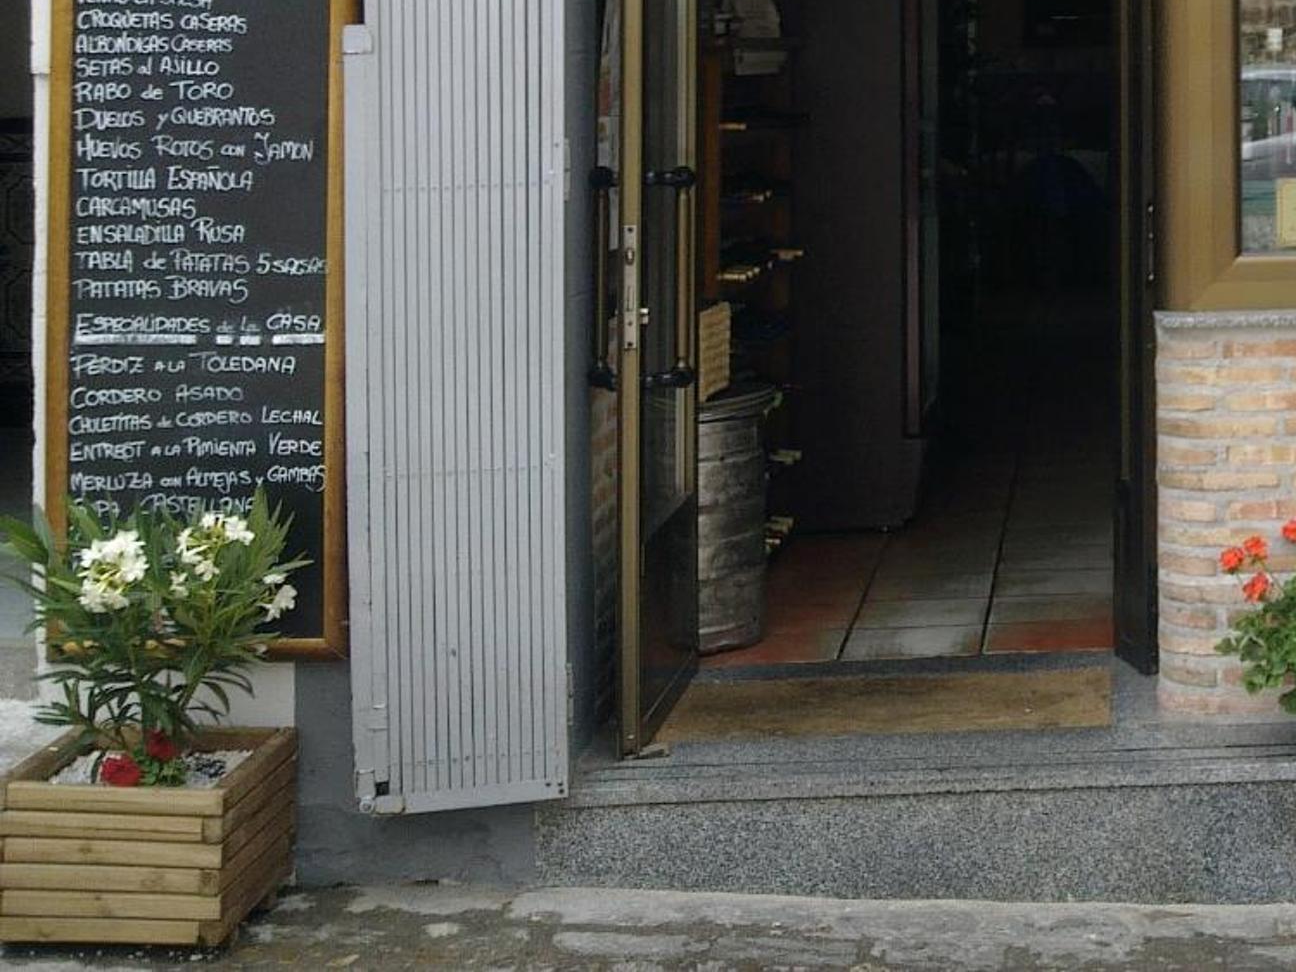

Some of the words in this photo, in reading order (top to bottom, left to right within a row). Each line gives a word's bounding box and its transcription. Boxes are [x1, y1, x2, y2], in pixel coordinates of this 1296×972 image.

[77, 8, 174, 29] CROQUETAS
[180, 12, 248, 34] CASERAS
[75, 32, 169, 53] ALBONDIGAS
[170, 34, 233, 52] CASERAS
[75, 58, 133, 77] SETAS
[137, 57, 152, 75] al
[159, 56, 220, 75] AJILLO
[74, 82, 132, 103] RABO
[140, 84, 164, 100] de
[169, 80, 234, 100] TORO
[72, 108, 146, 129] DUELOS
[157, 112, 169, 131] y
[170, 106, 276, 127] QUEBRANTOS
[76, 133, 142, 161] HUEVOS
[150, 134, 214, 160] ROTOS
[253, 131, 314, 165] JAMON
[75, 165, 156, 192] TORTILLA
[166, 165, 253, 191] ESPAÑOLA
[76, 197, 197, 220] CARCAMUSAS
[76, 222, 185, 245] ENSALADILLA
[190, 216, 245, 245] RUSA
[74, 249, 133, 273] TABLA
[143, 250, 167, 270] de
[169, 248, 250, 274] PATATAS
[256, 253, 271, 275] 5
[72, 278, 162, 300] PATATAS
[164, 275, 249, 304] BRAVAS
[75, 313, 211, 334] ESPECIALIDADES
[217, 319, 234, 333] de
[266, 313, 321, 331] CASA
[70, 353, 145, 377] PERDIZ
[189, 350, 296, 375] TOLEDANA
[70, 387, 162, 409] CORDERO
[175, 383, 244, 403] ASADO
[175, 411, 253, 428] CORDERO
[261, 405, 323, 425] LECHAL
[164, 444, 181, 456] LA
[182, 436, 256, 458] PIMIENTA
[267, 431, 323, 456] VERDE
[70, 471, 152, 494] MERLUZA
[186, 466, 251, 494] ALMEJAS
[266, 465, 328, 493] GAMBAS
